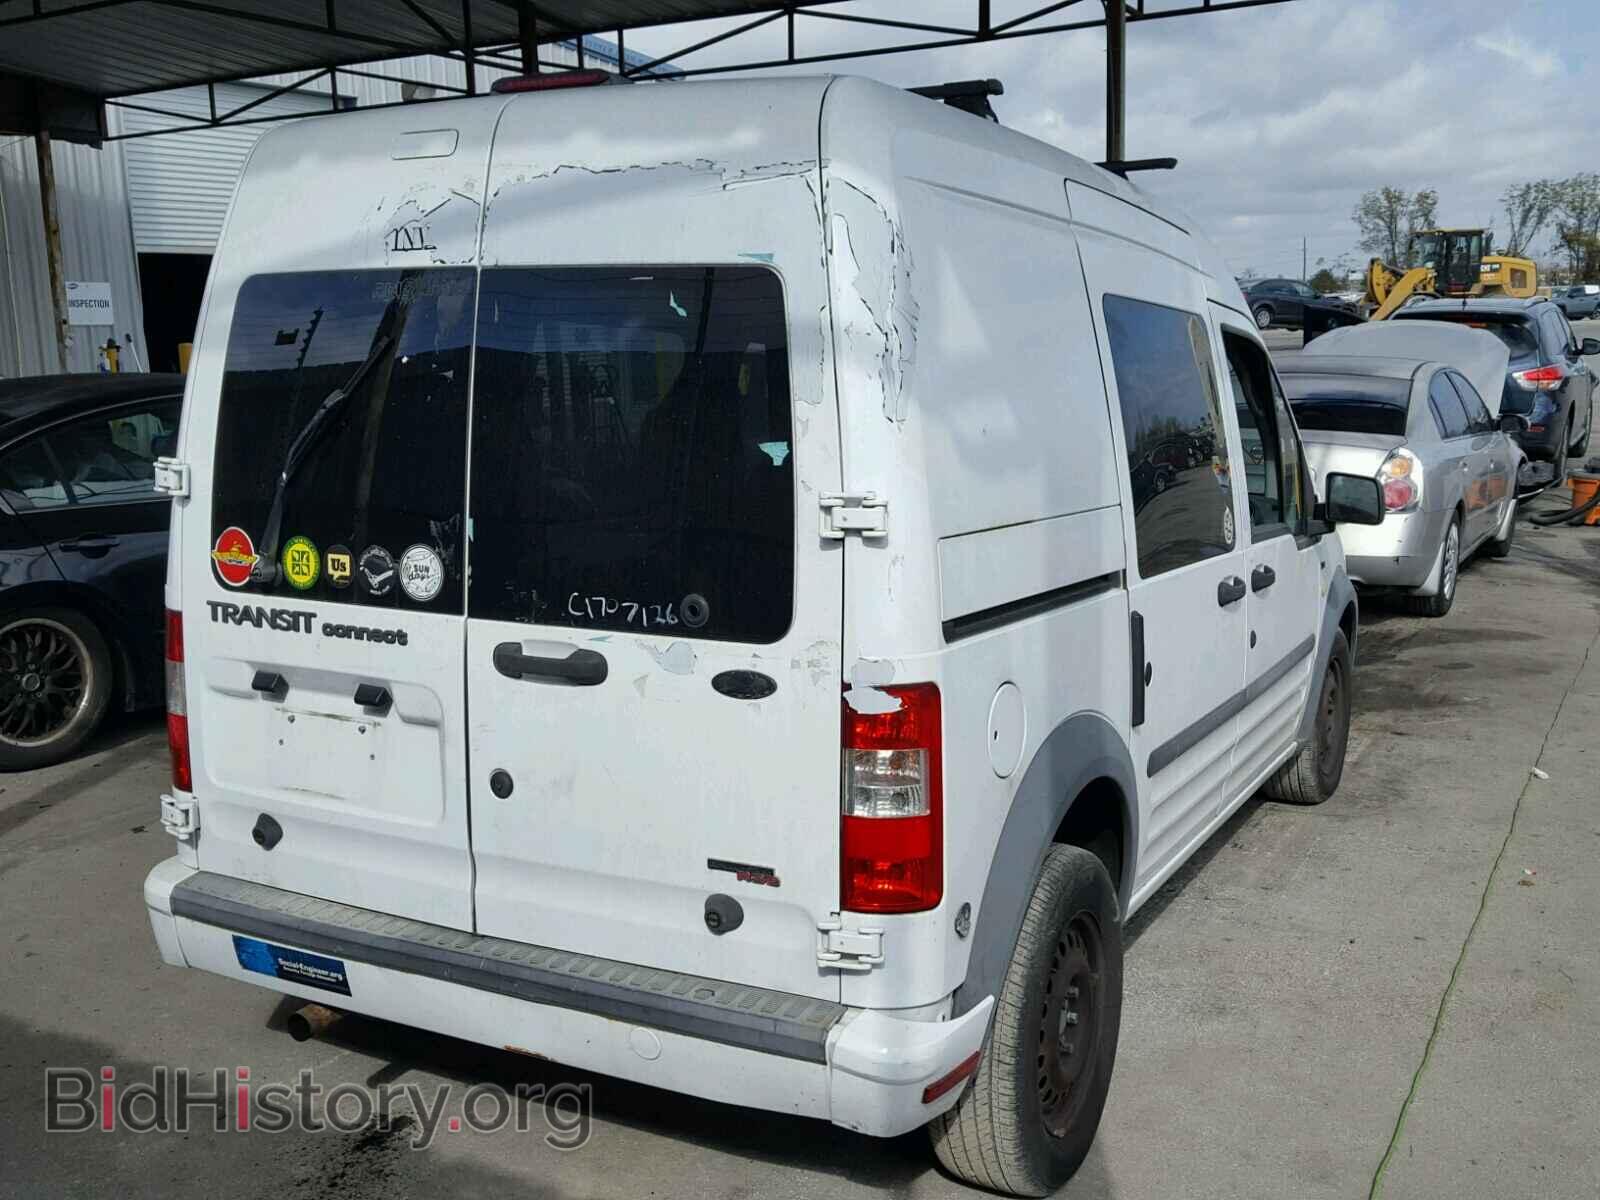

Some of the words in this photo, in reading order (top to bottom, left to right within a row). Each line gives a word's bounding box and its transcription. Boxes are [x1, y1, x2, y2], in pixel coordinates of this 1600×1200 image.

[68, 299, 110, 309] INSPECTION
[331, 558, 347, 572] Us
[206, 600, 318, 634] TRANSIT
[322, 622, 409, 646] connect
